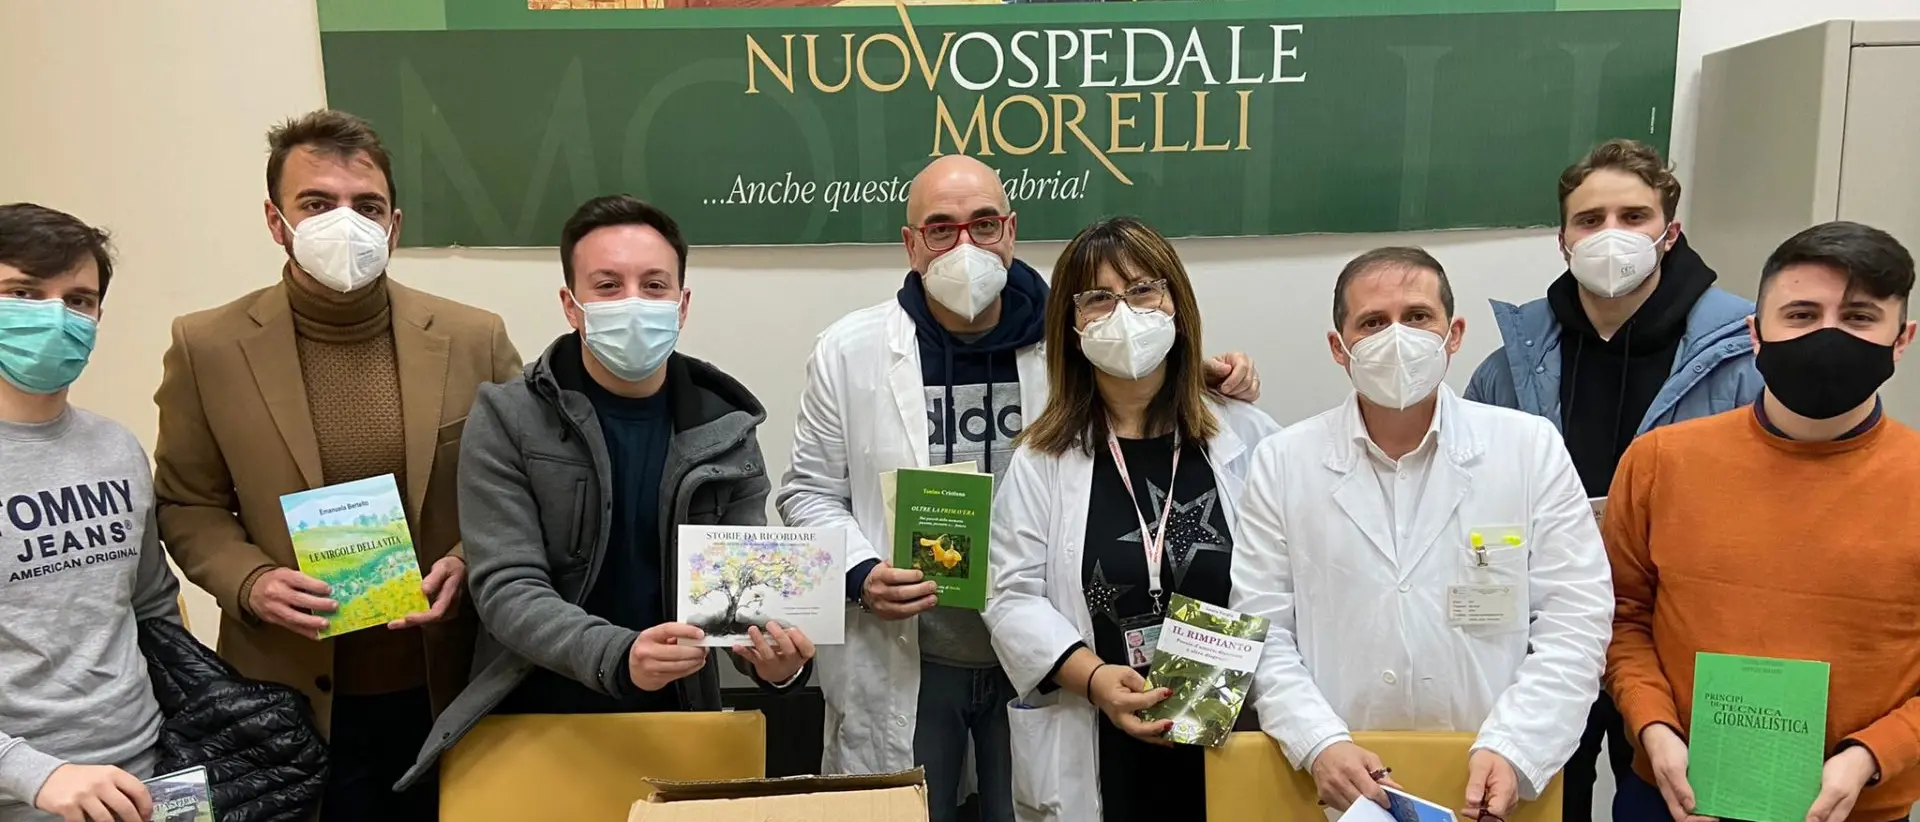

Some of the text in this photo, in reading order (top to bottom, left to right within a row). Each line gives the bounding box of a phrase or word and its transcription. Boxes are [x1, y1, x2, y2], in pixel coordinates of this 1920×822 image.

[928, 89, 1254, 185] MORELLI
[995, 167, 1091, 201] abria!
[0, 479, 133, 537] OMMY
[911, 505, 931, 513] OLTRE
[309, 536, 402, 563] LE VIRGOLE DELLA VITA
[706, 532, 817, 541] STORIE DA RICORDARE
[9, 547, 138, 582] AMERICAN ORIGINAL
[1172, 625, 1184, 637] IL
[1186, 630, 1253, 654] RIMPIANTO
[1704, 692, 1744, 703] PRINCIPI
[1719, 703, 1783, 717] TECNICA
[1713, 711, 1810, 734] GIORNALISTICA
